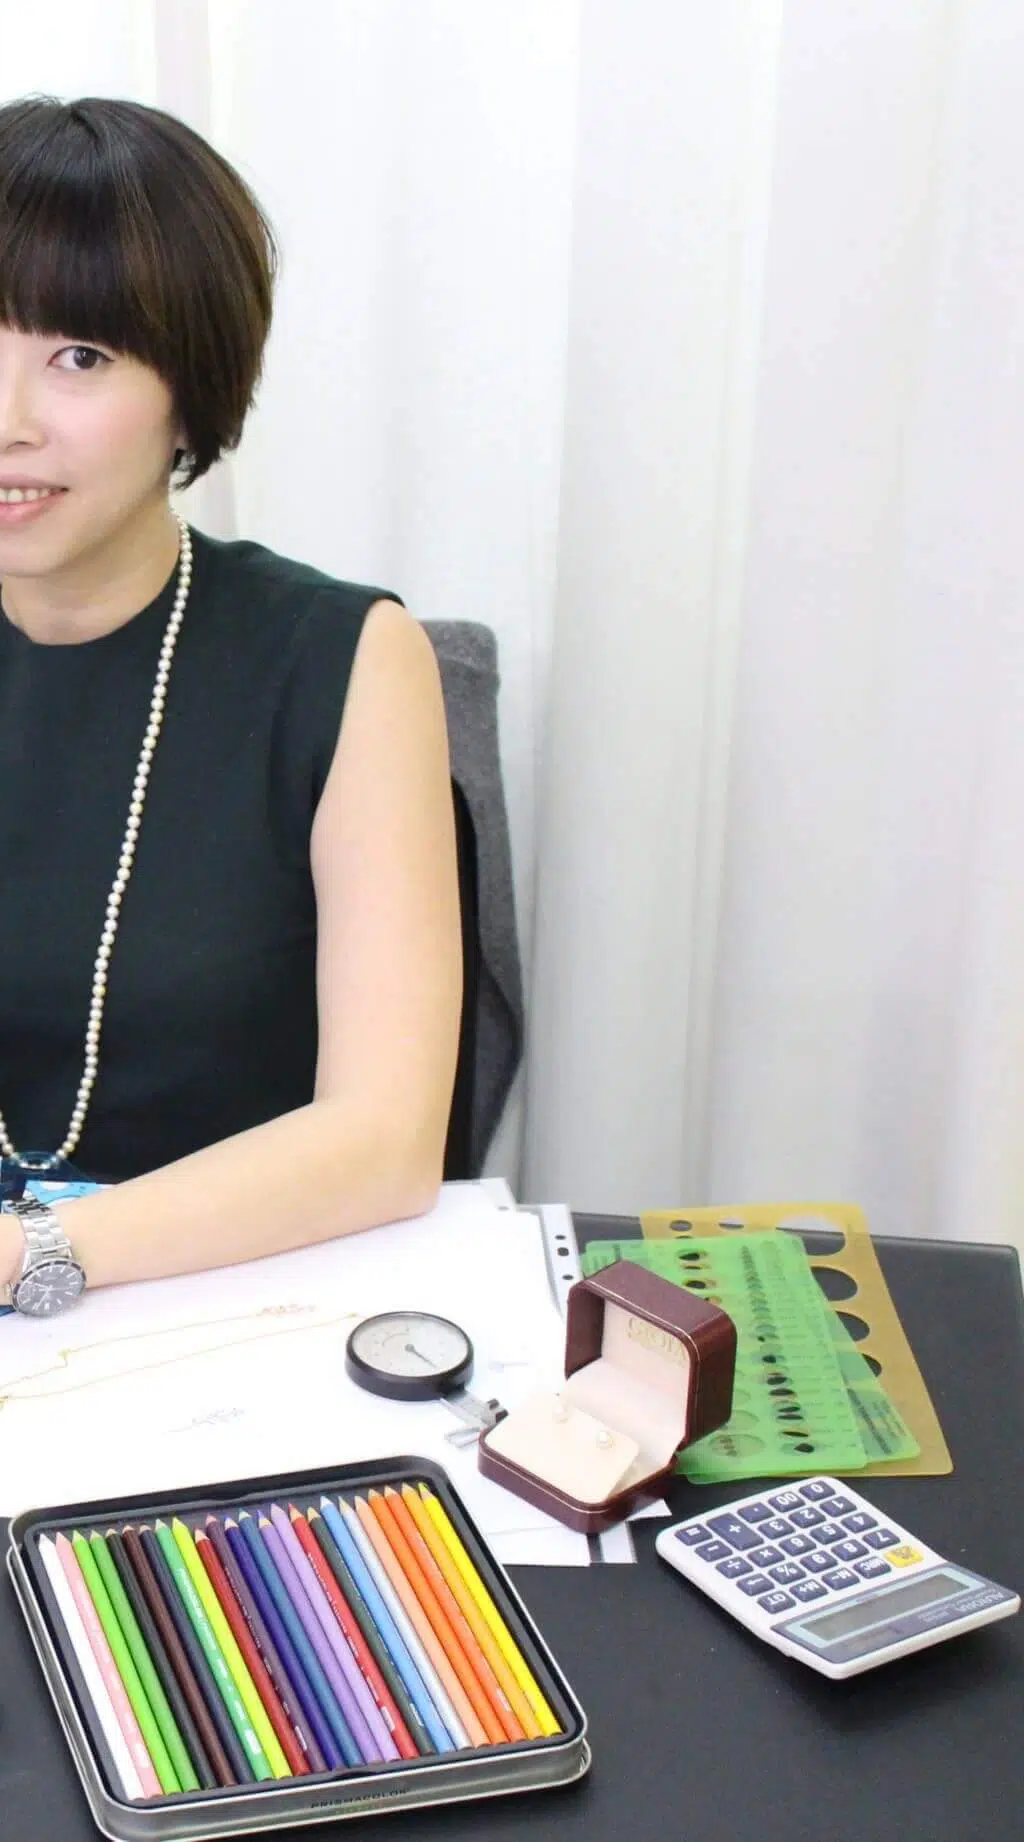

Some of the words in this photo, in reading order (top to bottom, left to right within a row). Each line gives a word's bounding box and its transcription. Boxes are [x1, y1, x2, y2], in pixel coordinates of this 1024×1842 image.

[811, 1484, 824, 1493] 0
[776, 1493, 796, 1505] 00
[831, 1500, 843, 1509] 1
[800, 1509, 815, 1519] 2
[852, 1516, 865, 1525] 4
[769, 1521, 783, 1531] 3
[823, 1525, 836, 1535] 5
[876, 1532, 890, 1542] 7
[790, 1538, 804, 1547] 6
[842, 1542, 857, 1553] 8
[811, 1554, 826, 1564] 9
[766, 1593, 786, 1605] GT
